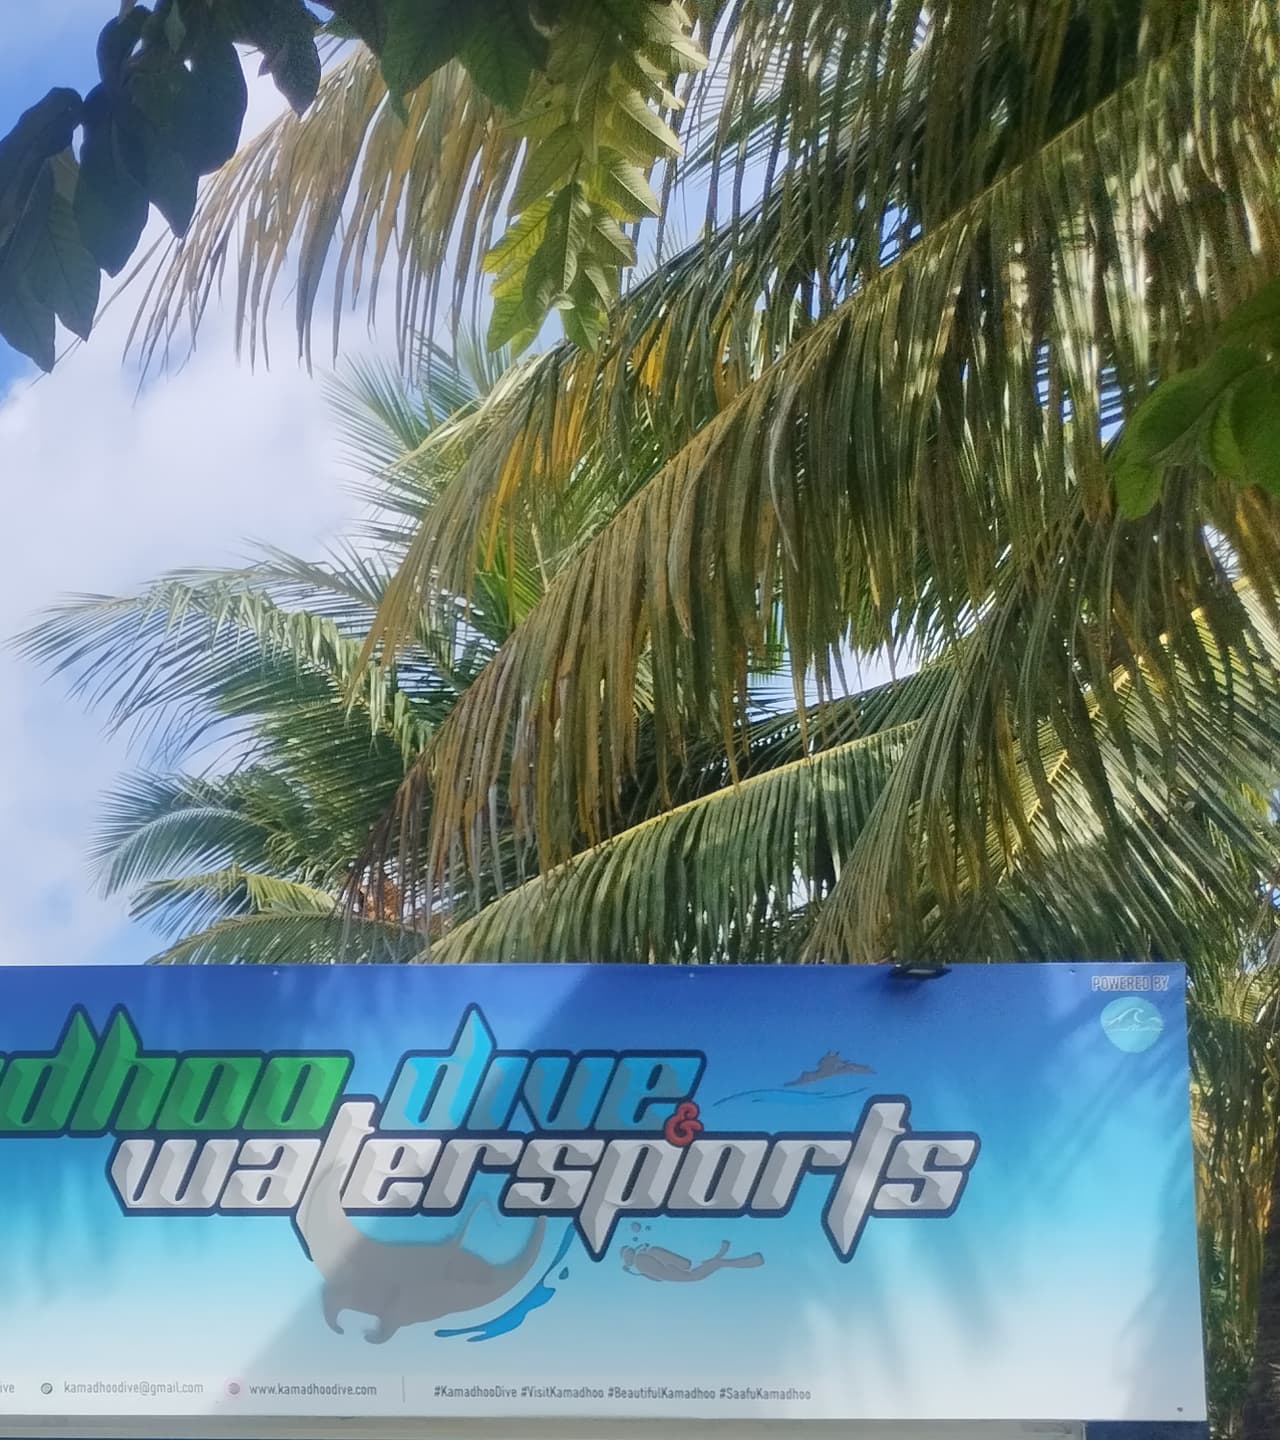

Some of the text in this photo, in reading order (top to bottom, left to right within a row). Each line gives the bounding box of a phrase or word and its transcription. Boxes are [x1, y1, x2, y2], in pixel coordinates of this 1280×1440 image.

[1091, 976, 1169, 991] POWERED BY
[663, 1101, 702, 1147] &
[106, 1093, 980, 1262] watersports
[63, 1381, 204, 1397] kamadhoodive@gmail.com
[249, 1383, 377, 1396] www.kamadhoodive.com
[434, 1385, 517, 1398] #KamadhooDive
[520, 1386, 604, 1399] #VisitKamadhoo
[607, 1386, 716, 1400] #BeautifulKamadhoo
